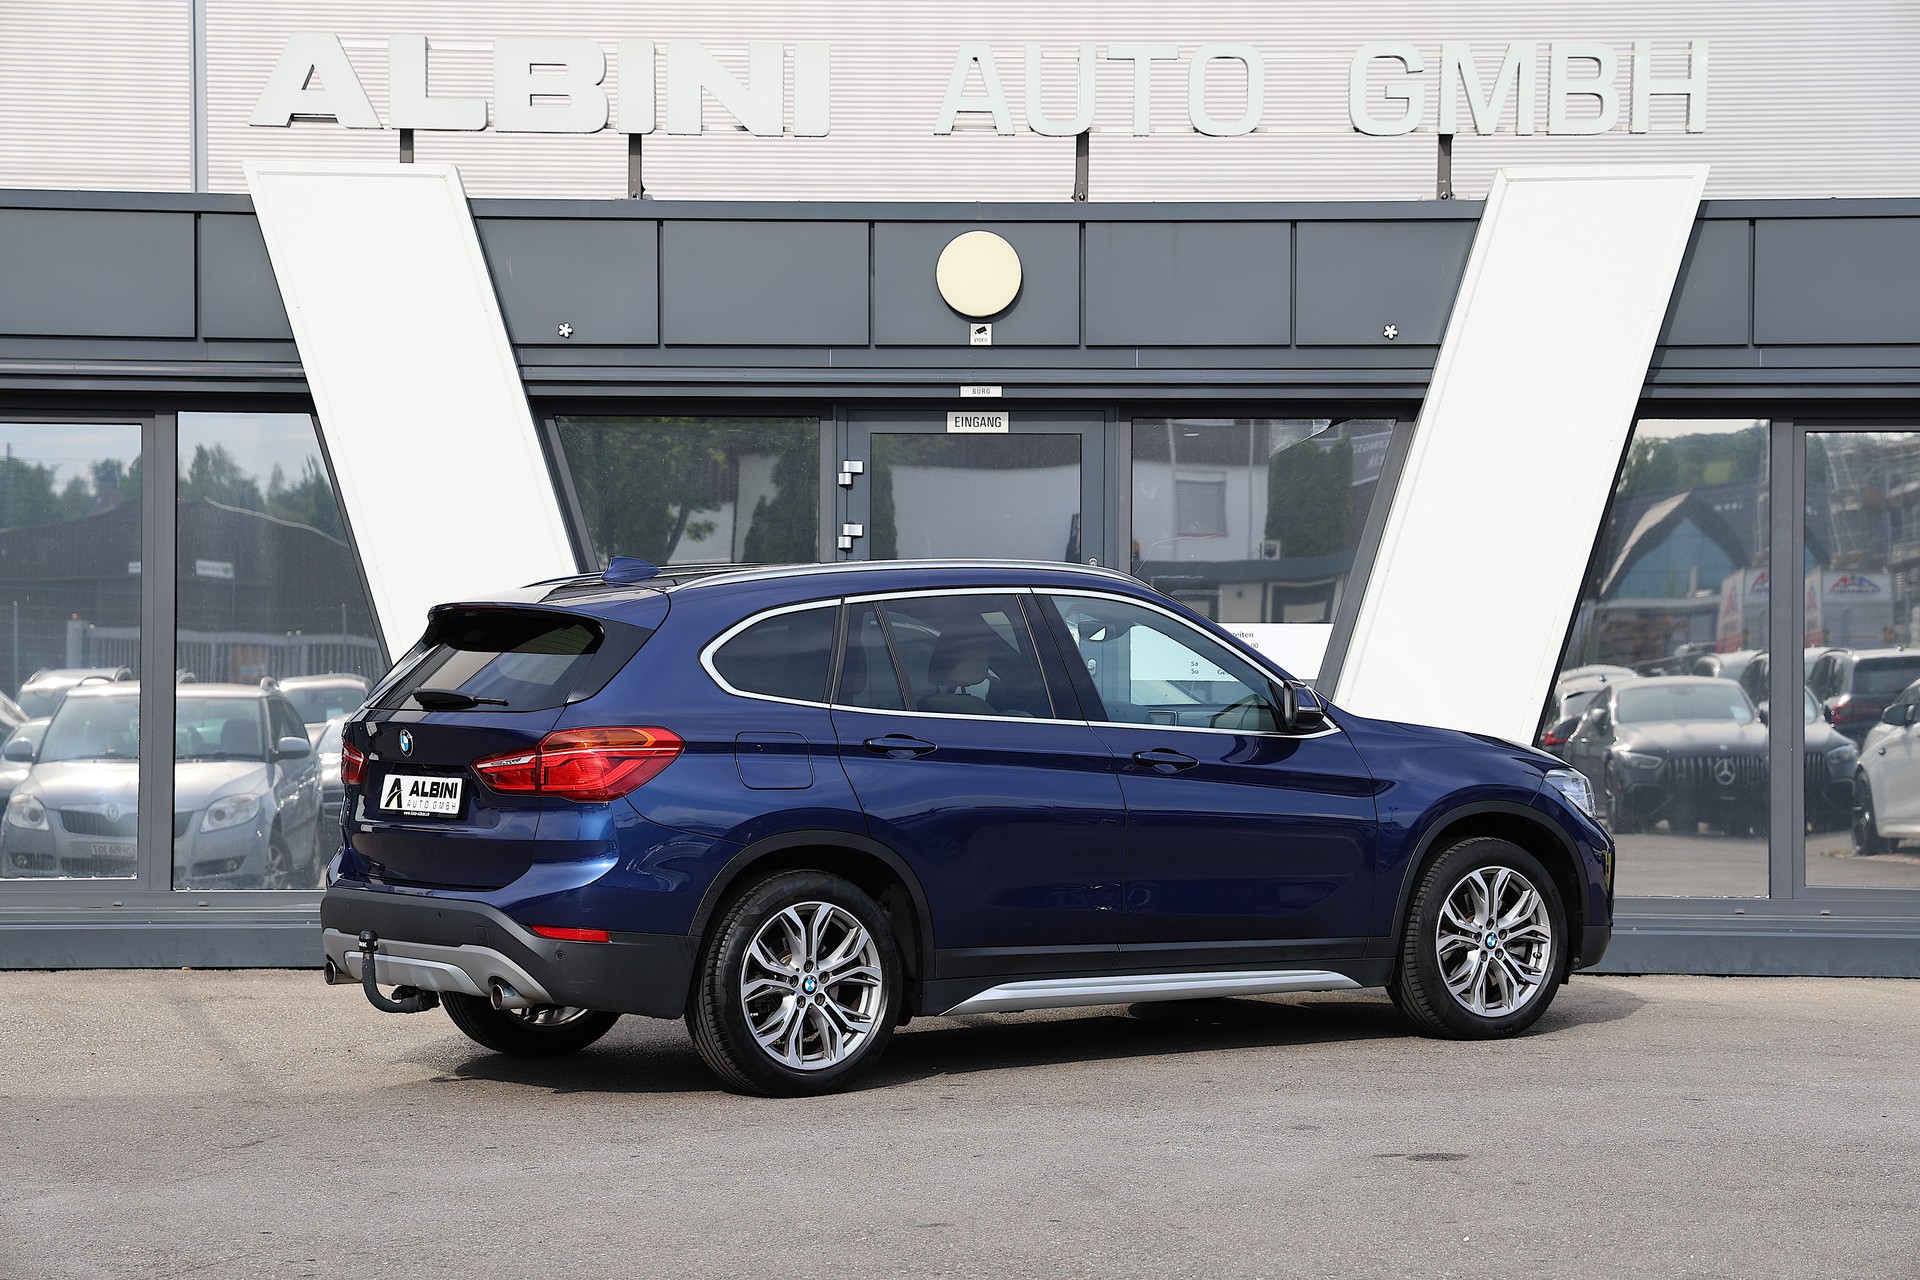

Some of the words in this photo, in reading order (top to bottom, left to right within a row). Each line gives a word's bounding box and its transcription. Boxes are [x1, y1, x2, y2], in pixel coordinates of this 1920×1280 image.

[248, 31, 832, 138] ALBINI
[933, 42, 1266, 137] AUTO
[1348, 41, 1710, 136] GMBH
[972, 387, 991, 395] BÜRO
[954, 416, 1002, 428] EINGANG
[409, 781, 458, 799] ALBINI
[406, 799, 429, 809] AUTO
[432, 800, 457, 811] GMBH
